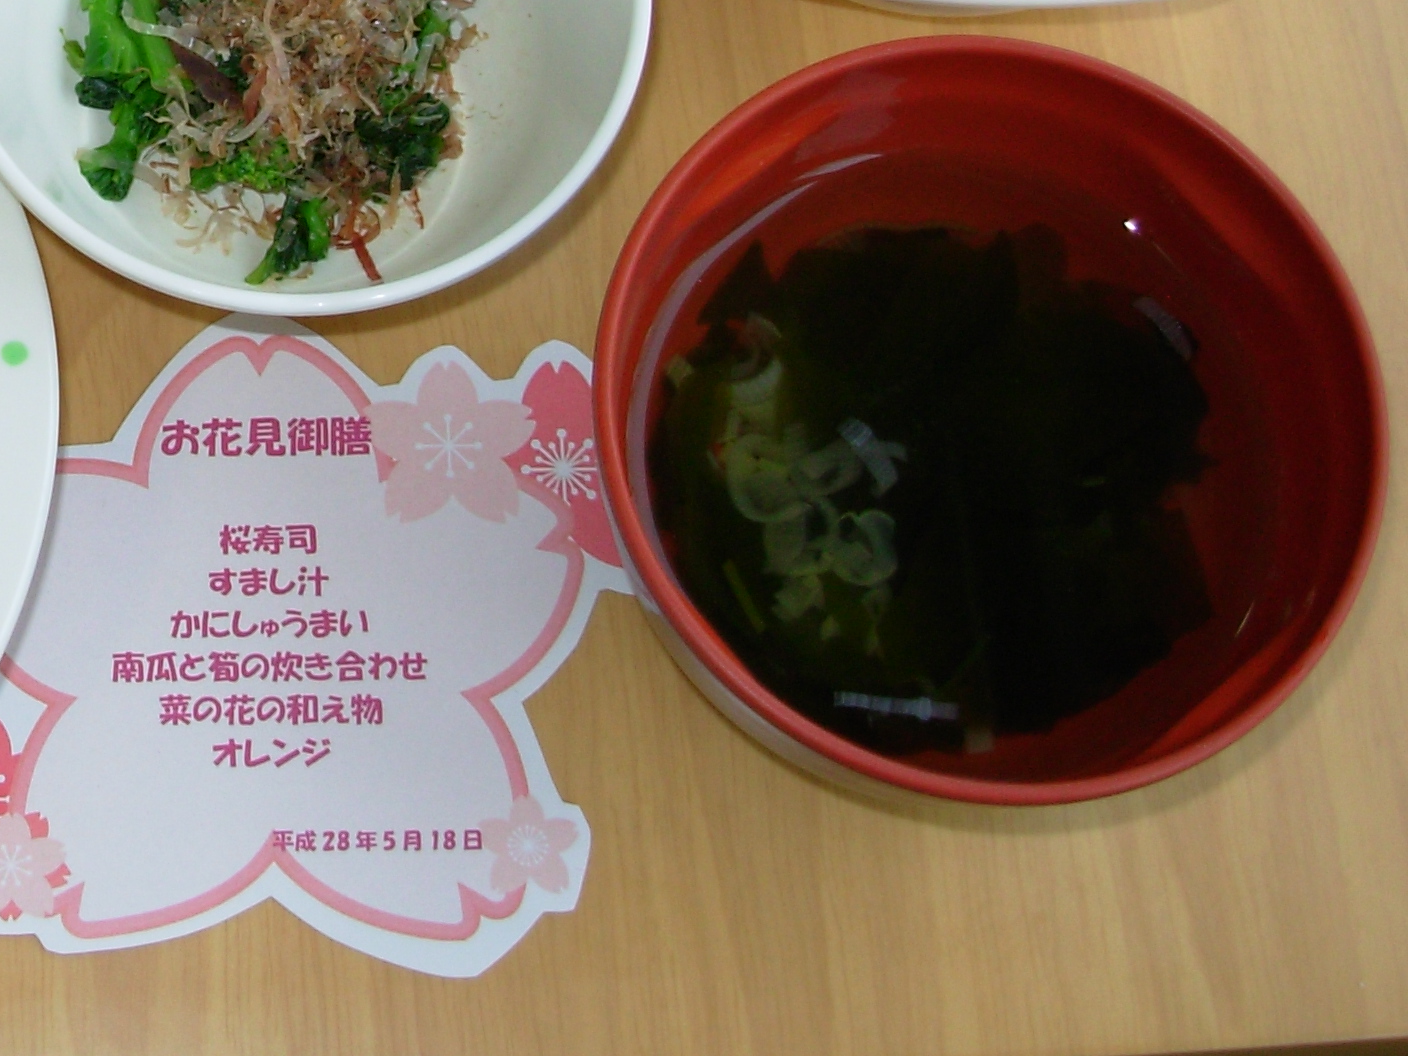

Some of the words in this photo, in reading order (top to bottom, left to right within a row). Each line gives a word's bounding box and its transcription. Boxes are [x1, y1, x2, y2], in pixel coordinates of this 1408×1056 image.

[160, 416, 373, 457] お花見御膳
[219, 524, 318, 555] 桜寿司
[208, 565, 330, 597] すまし汁
[170, 609, 369, 639] かにしゅうまい
[112, 650, 428, 683] 南瓜と筍の炊き合わせ
[159, 693, 384, 726] 菜の花の和え物
[212, 738, 331, 768] オレンジ
[272, 829, 483, 854] 平成28年5月18日
